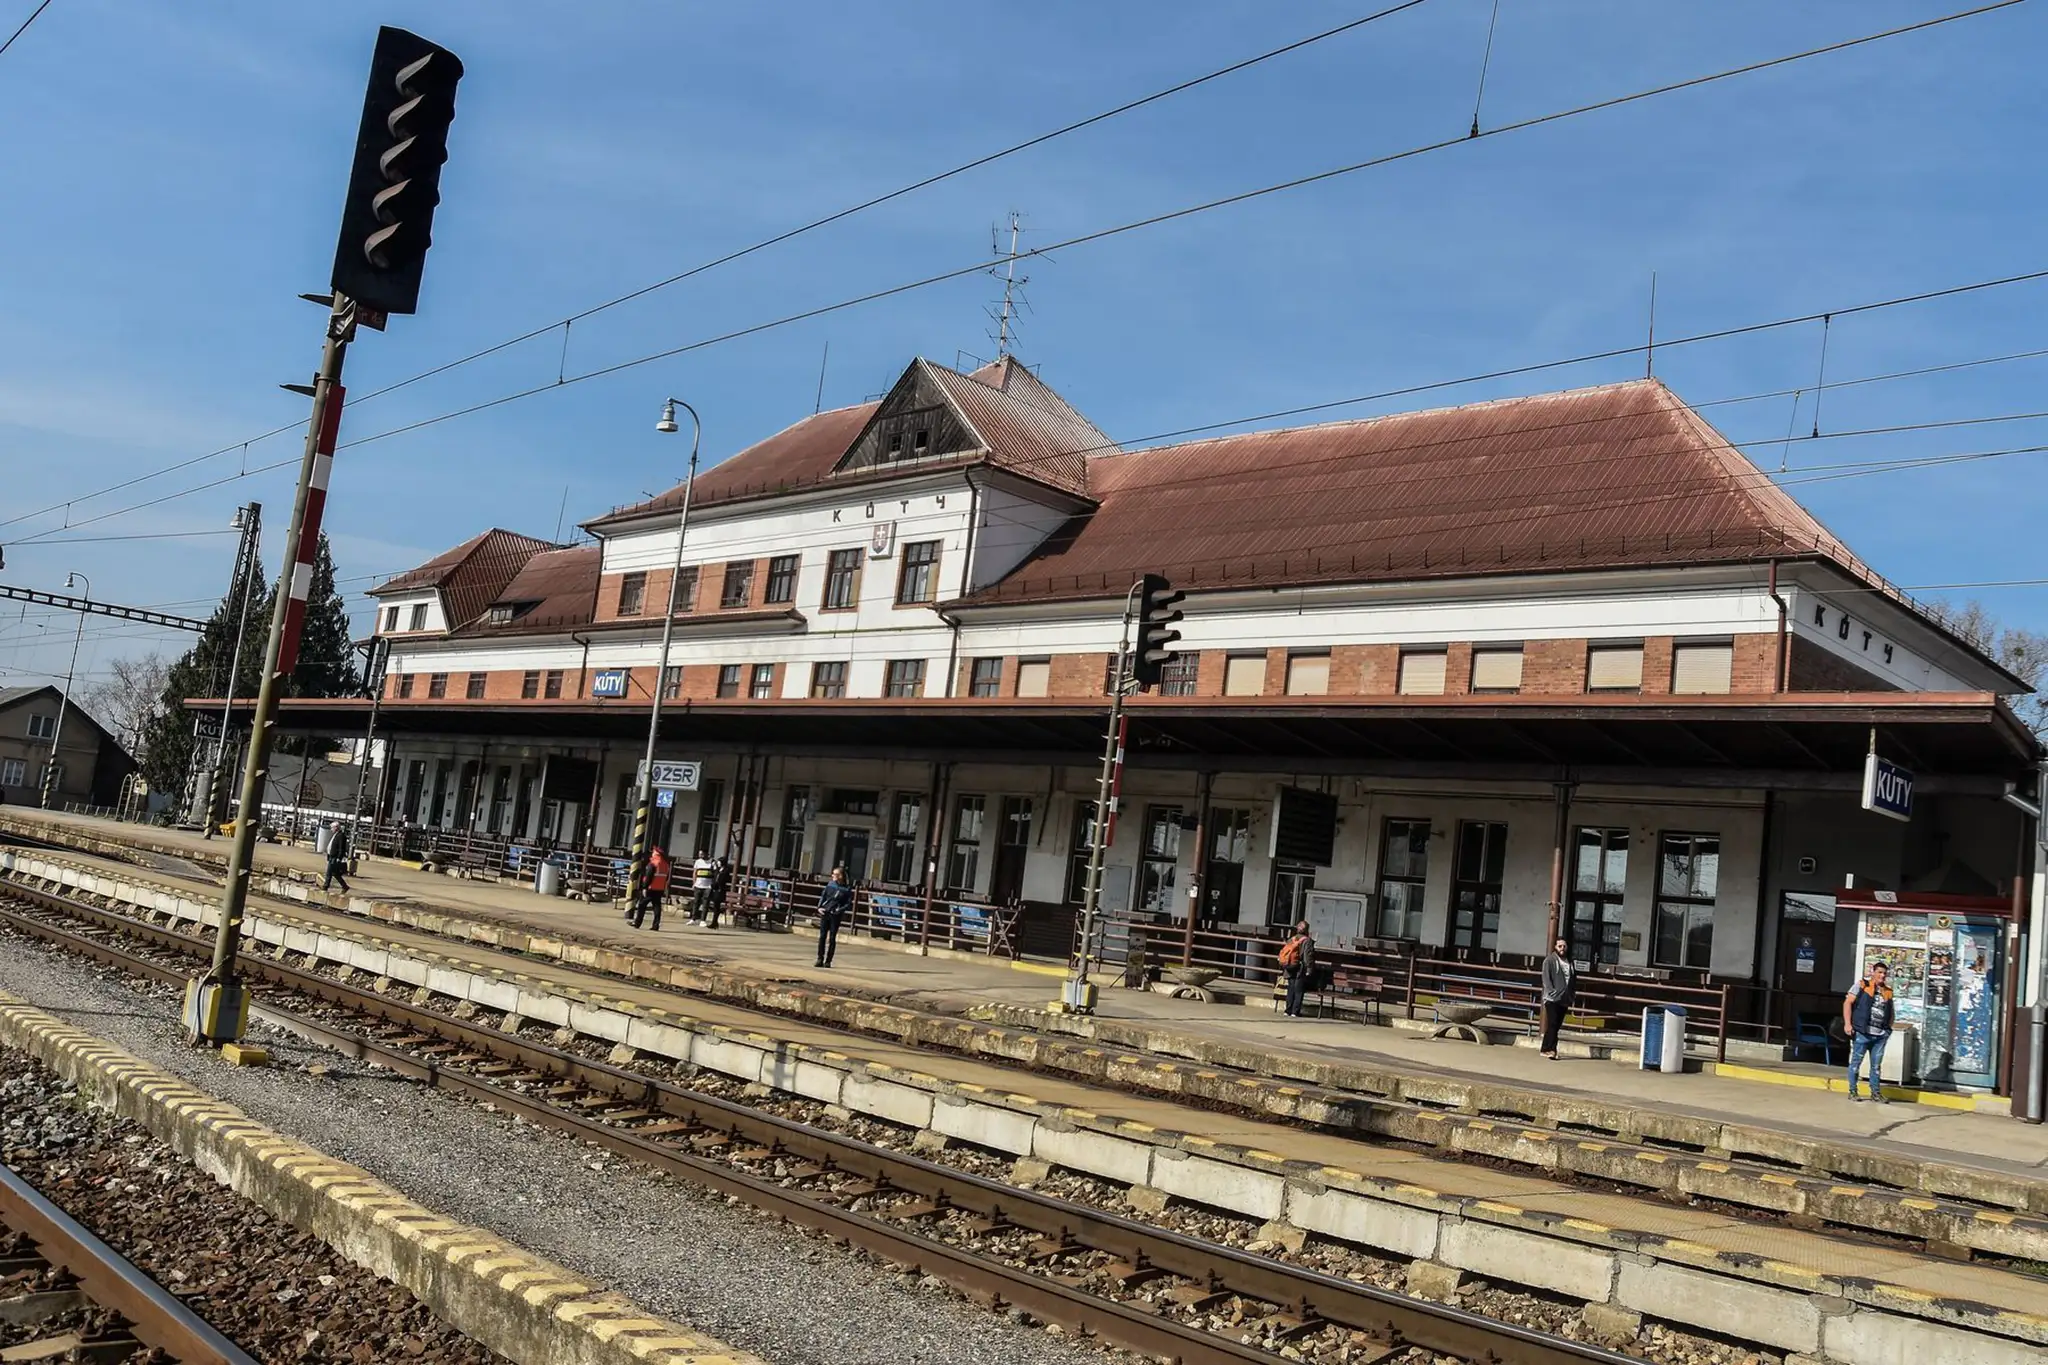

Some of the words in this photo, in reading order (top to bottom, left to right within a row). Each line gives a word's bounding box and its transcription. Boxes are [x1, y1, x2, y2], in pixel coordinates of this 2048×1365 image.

[832, 495, 945, 523] KÚTY
[1814, 604, 1894, 664] KÚTY
[594, 672, 622, 691] KÚTY
[661, 766, 694, 783] ŽSR
[1876, 767, 1913, 808] KÚTY
